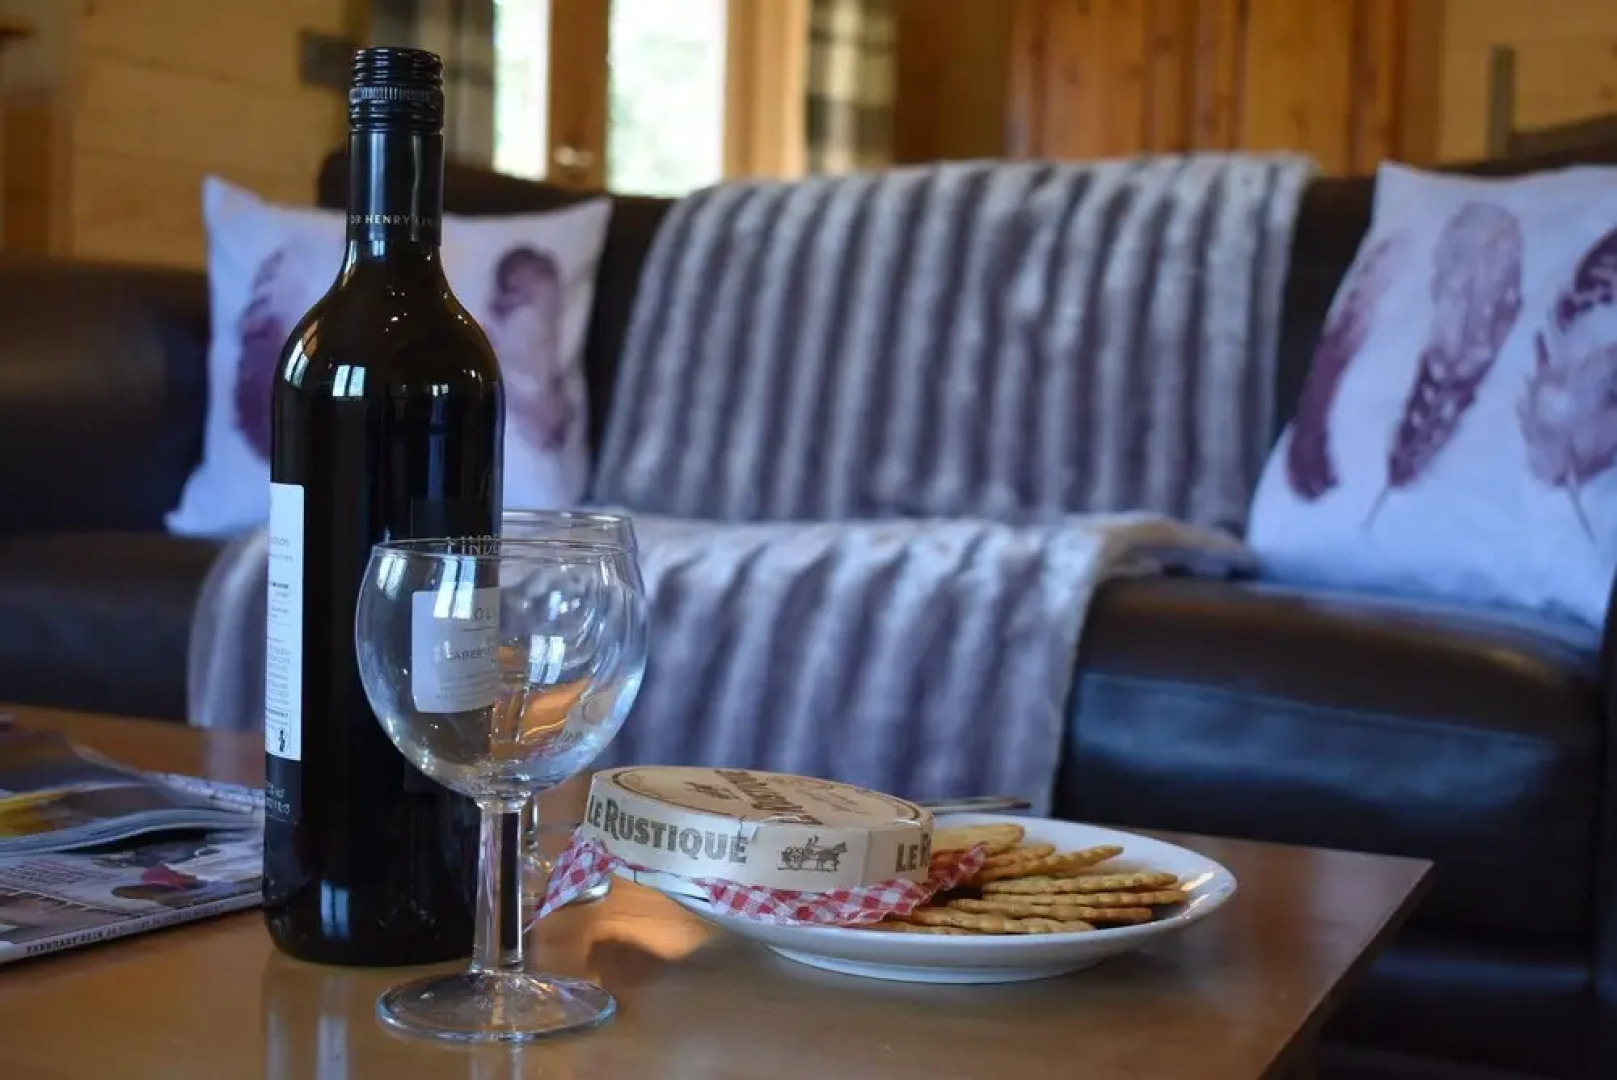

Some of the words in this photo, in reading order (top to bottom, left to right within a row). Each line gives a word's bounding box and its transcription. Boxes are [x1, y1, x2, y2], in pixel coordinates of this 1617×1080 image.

[364, 214, 411, 225] HENRY
[587, 795, 603, 828] LE
[603, 798, 748, 864] RUSTIQUE
[895, 843, 919, 872] LE
